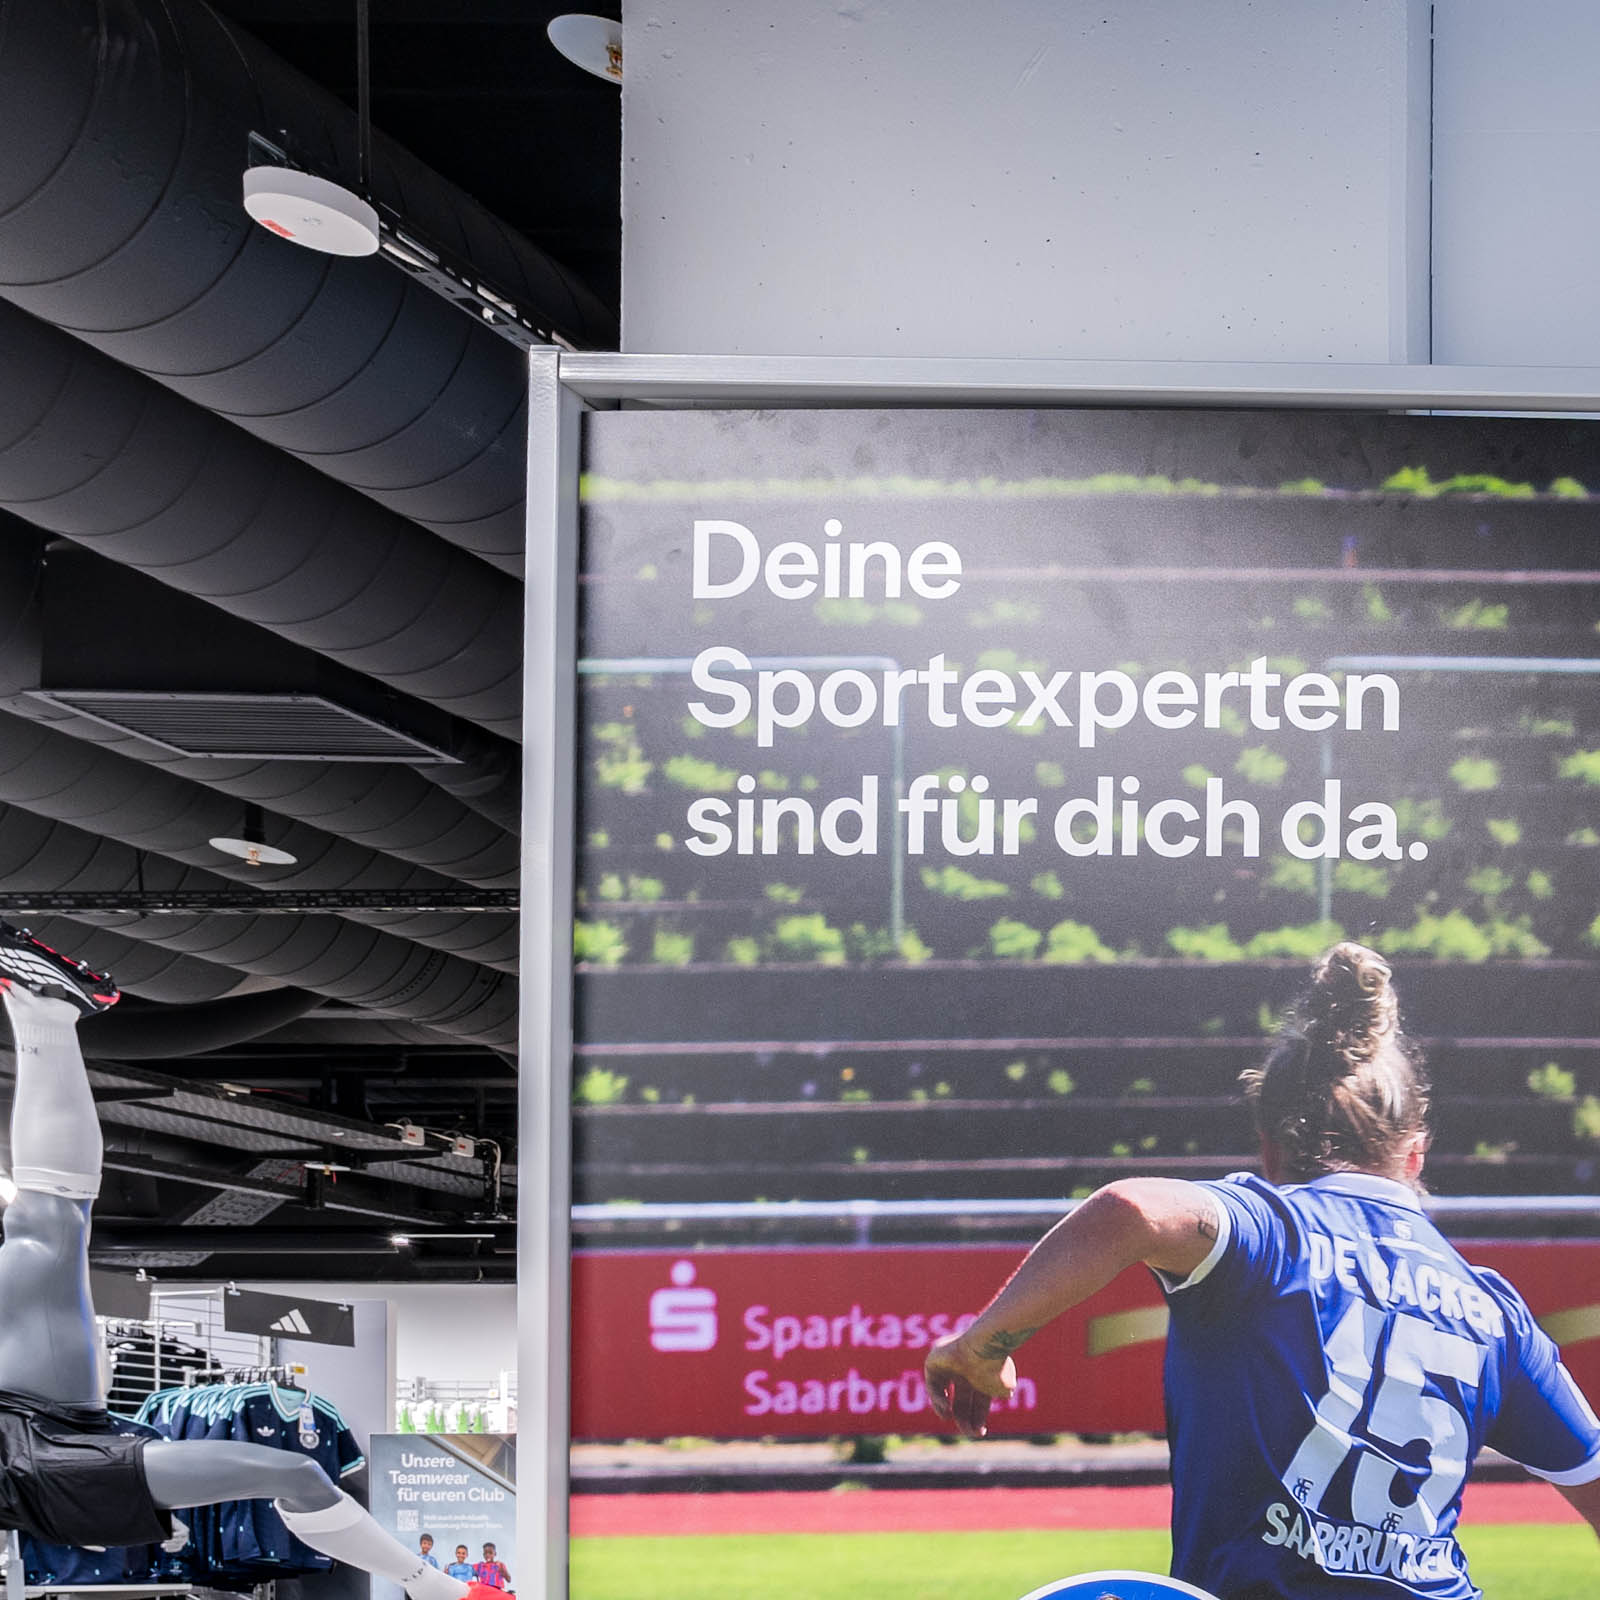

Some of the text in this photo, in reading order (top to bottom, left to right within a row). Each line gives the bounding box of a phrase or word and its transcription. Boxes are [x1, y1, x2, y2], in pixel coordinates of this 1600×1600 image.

[692, 518, 963, 600] Deine
[688, 646, 1400, 747] Sportexperten
[685, 773, 1429, 861] sind für dich da.
[1308, 1231, 1360, 1290] DE
[744, 1368, 1036, 1416] Saarbrün
[1281, 1295, 1489, 1536] 15
[389, 1470, 470, 1485] Teamwear
[401, 1454, 455, 1468] Unsere
[397, 1487, 505, 1502] für euren Club
